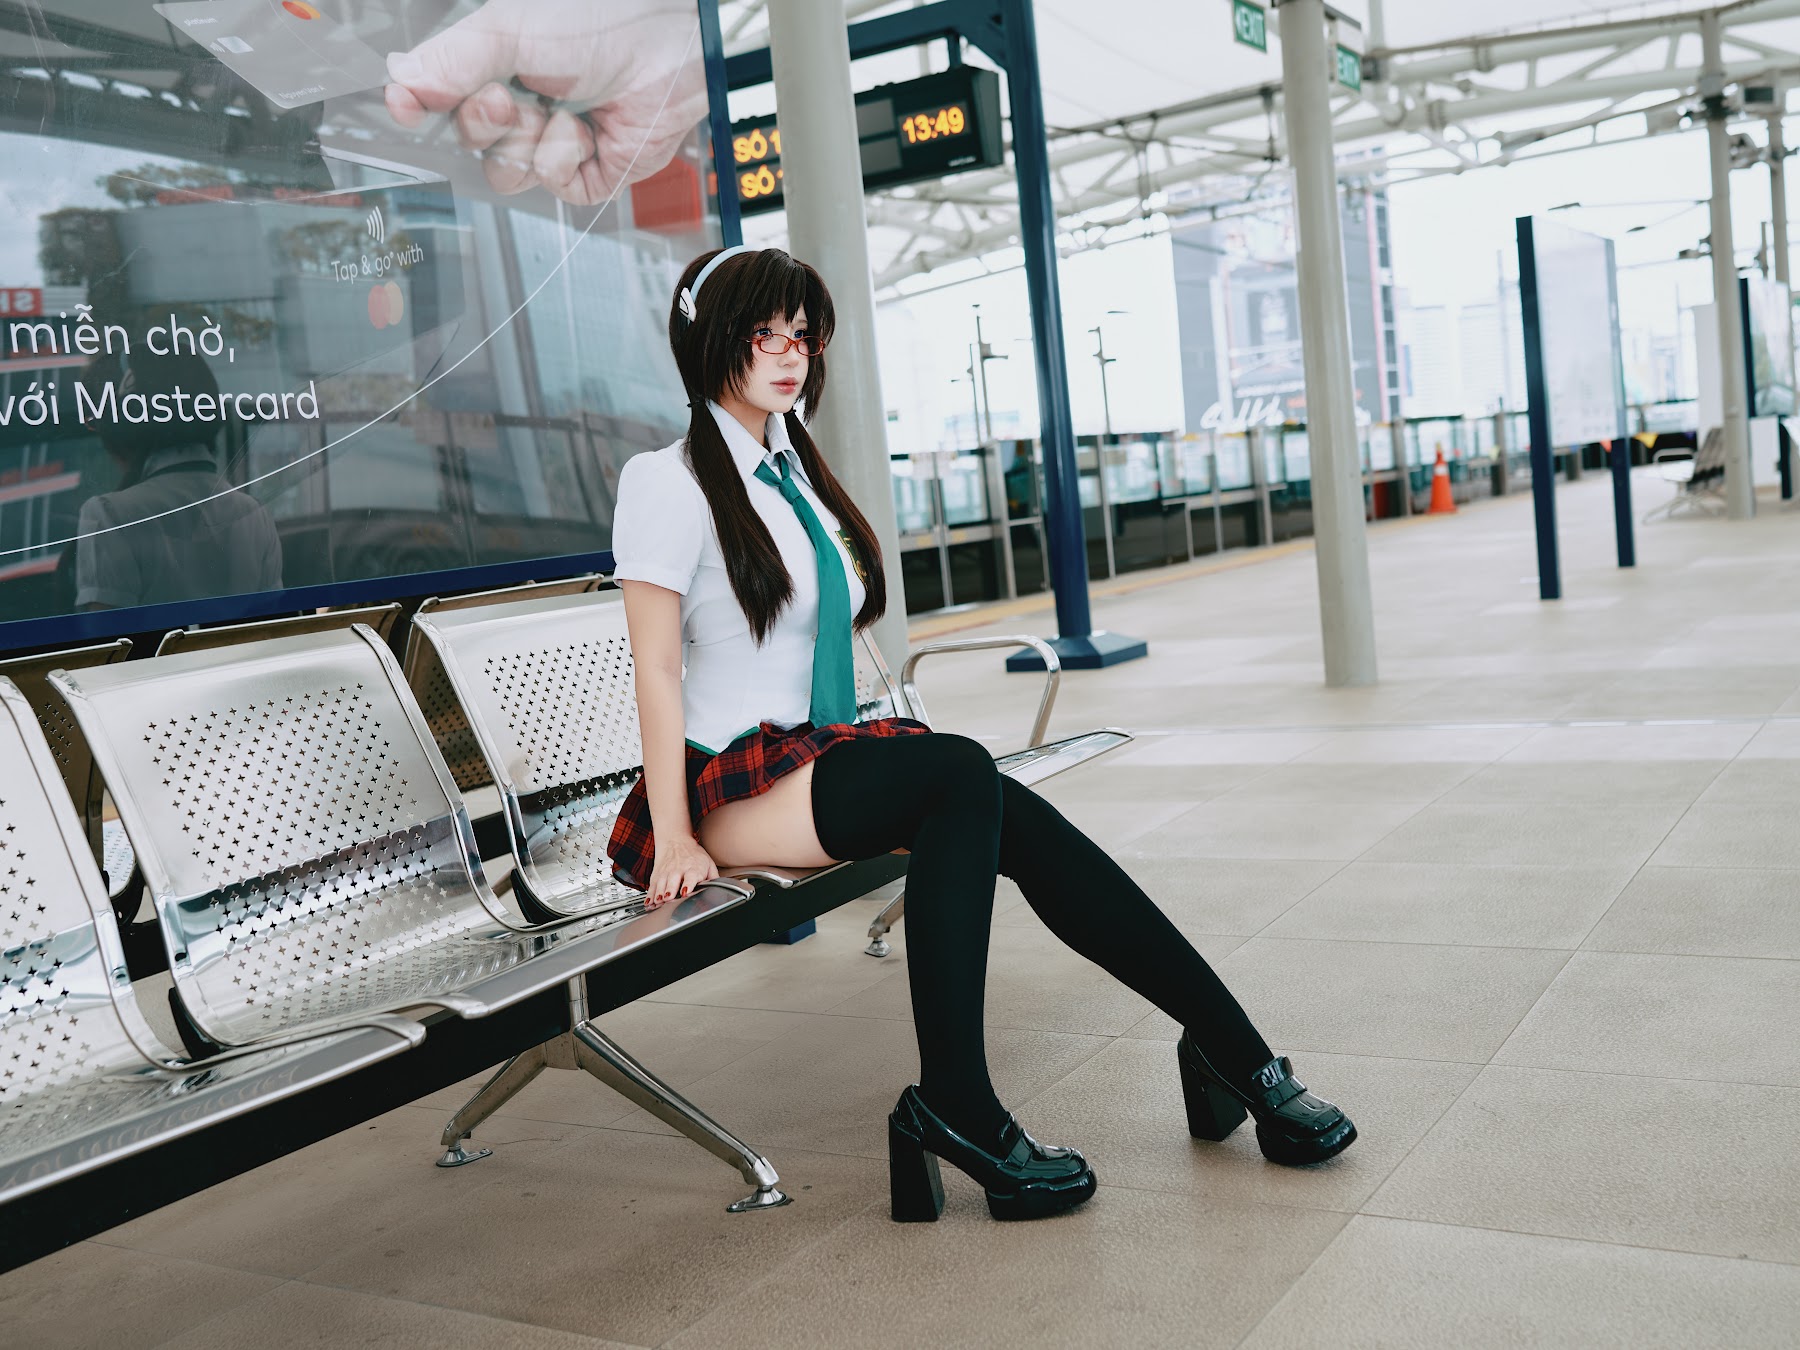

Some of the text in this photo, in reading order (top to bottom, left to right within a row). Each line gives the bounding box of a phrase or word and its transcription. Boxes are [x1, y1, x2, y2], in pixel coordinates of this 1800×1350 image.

[1239, 6, 1265, 47] EXIT
[902, 106, 965, 144] 13:49
[331, 260, 358, 284] Tap
[361, 254, 372, 275] &
[397, 243, 424, 267] with
[10, 303, 235, 363] miễn chờ,
[74, 380, 320, 424] Mastercard
